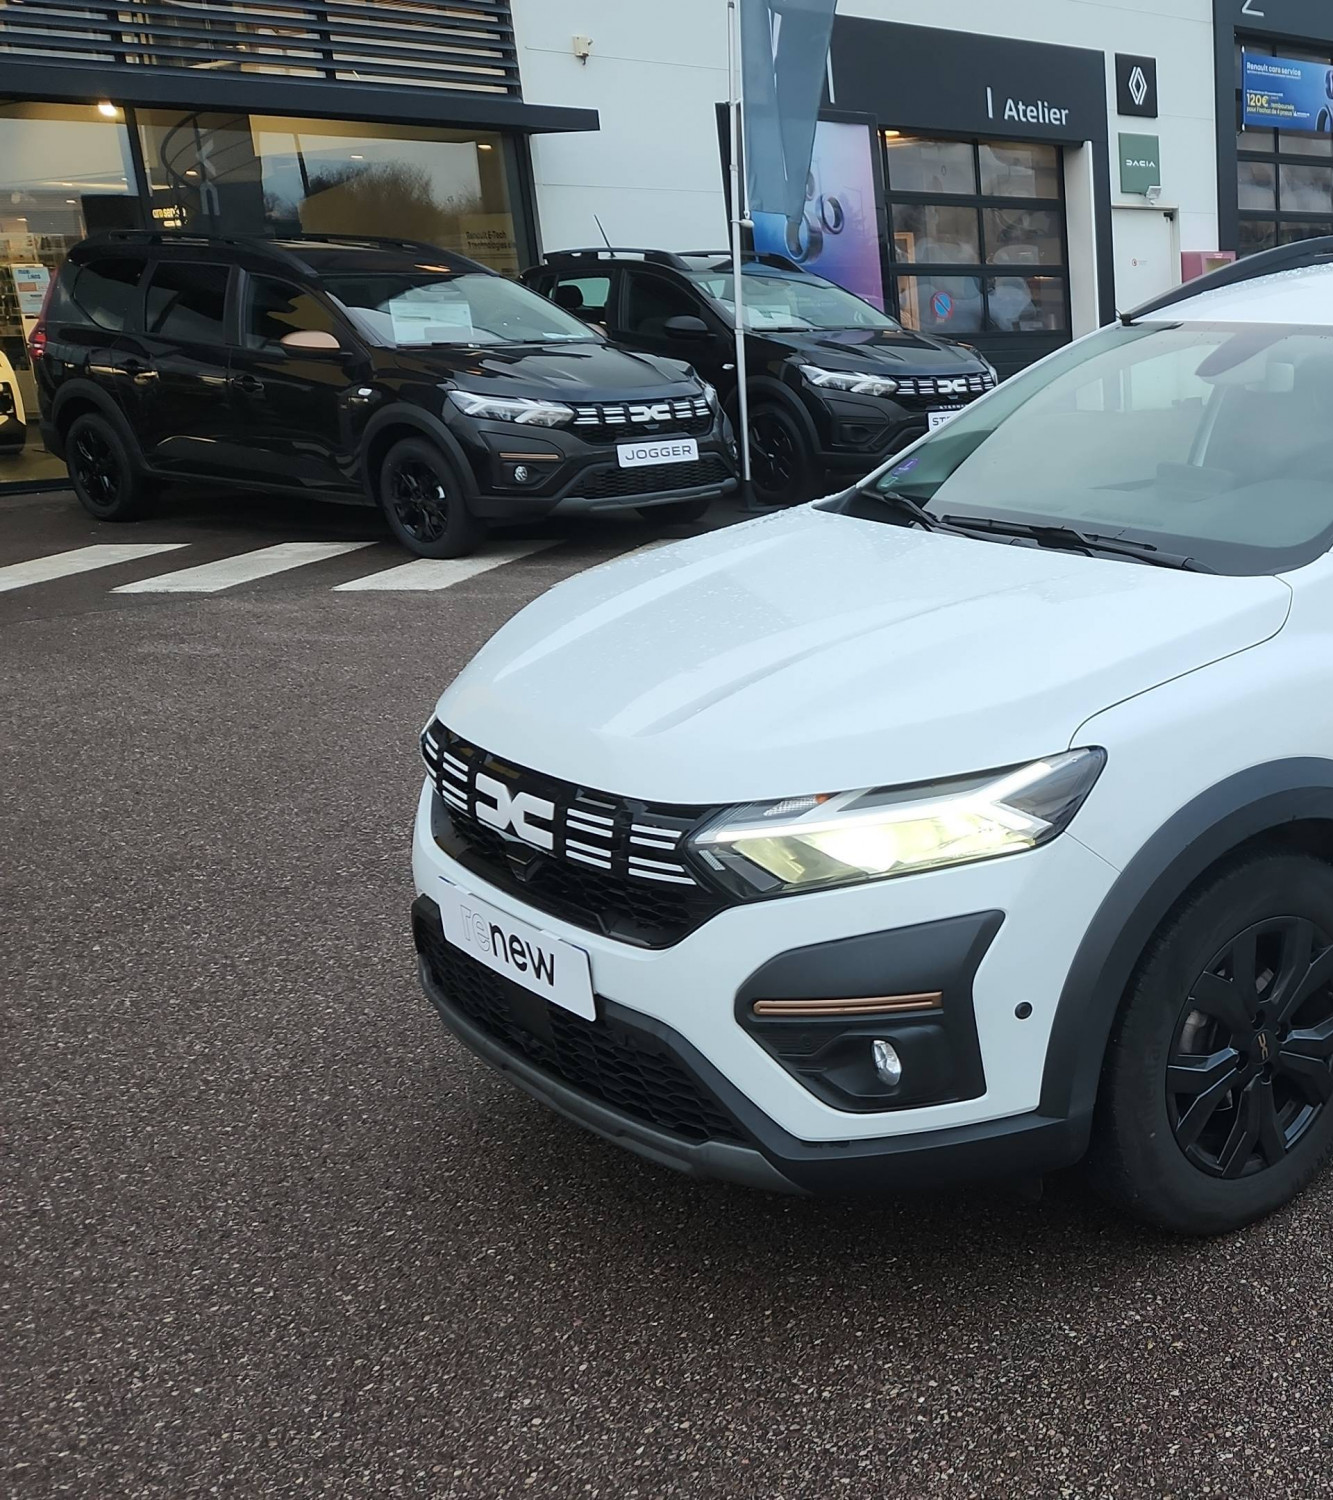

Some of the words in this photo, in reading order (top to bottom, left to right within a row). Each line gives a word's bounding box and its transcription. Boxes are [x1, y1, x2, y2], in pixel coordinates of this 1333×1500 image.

[1247, 62, 1268, 72] Renault
[1281, 68, 1301, 76] service
[1246, 93, 1269, 107] 120€
[1004, 98, 1069, 126] Atelier
[1125, 159, 1156, 168] DACIA
[625, 445, 692, 461] JOGGER
[459, 903, 555, 988] renew
